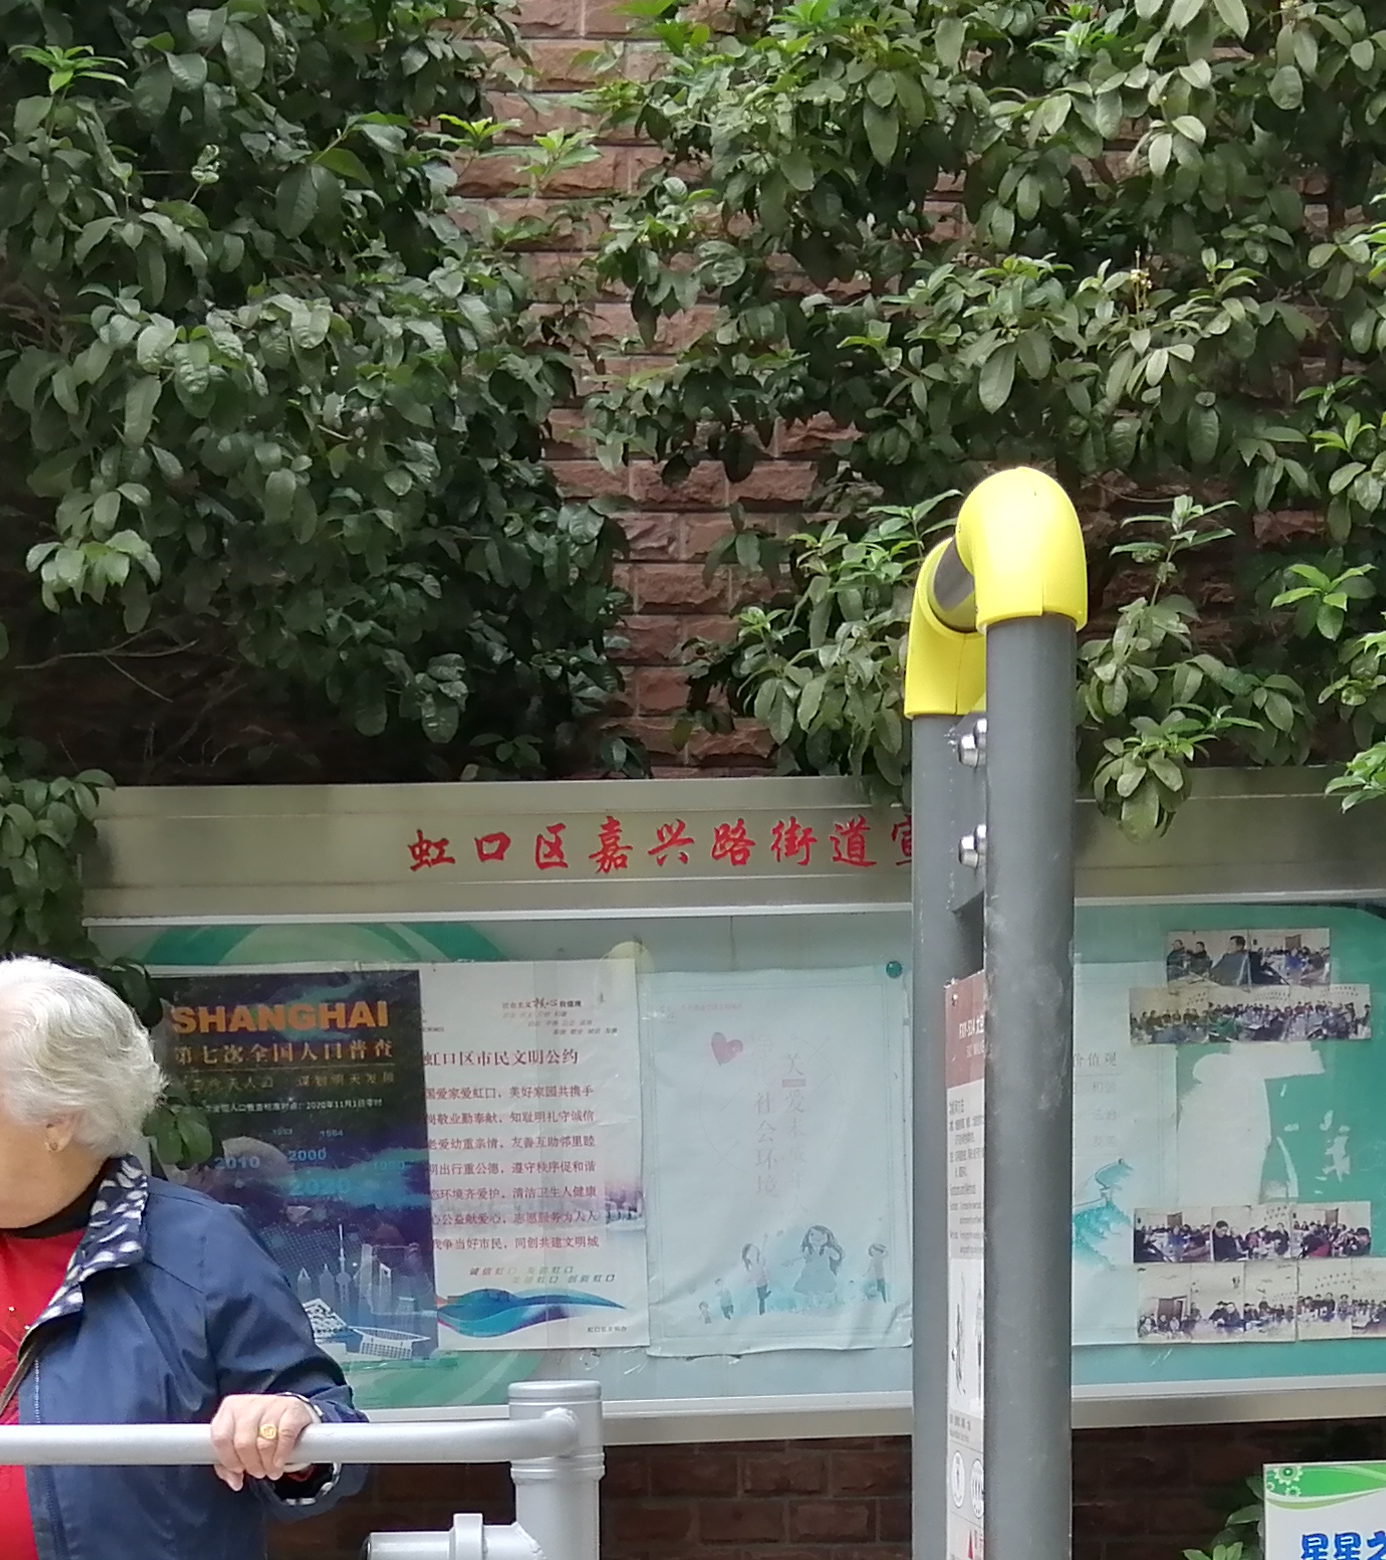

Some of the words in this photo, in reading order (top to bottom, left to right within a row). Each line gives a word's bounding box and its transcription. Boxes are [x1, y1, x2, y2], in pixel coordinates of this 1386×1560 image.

[172, 1000, 389, 1034] SHANGHAI
[175, 1038, 393, 1066] 第七次全国人口普查
[214, 1157, 261, 1169] 2010
[288, 1147, 328, 1162] 2000
[289, 1177, 351, 1197] 2020
